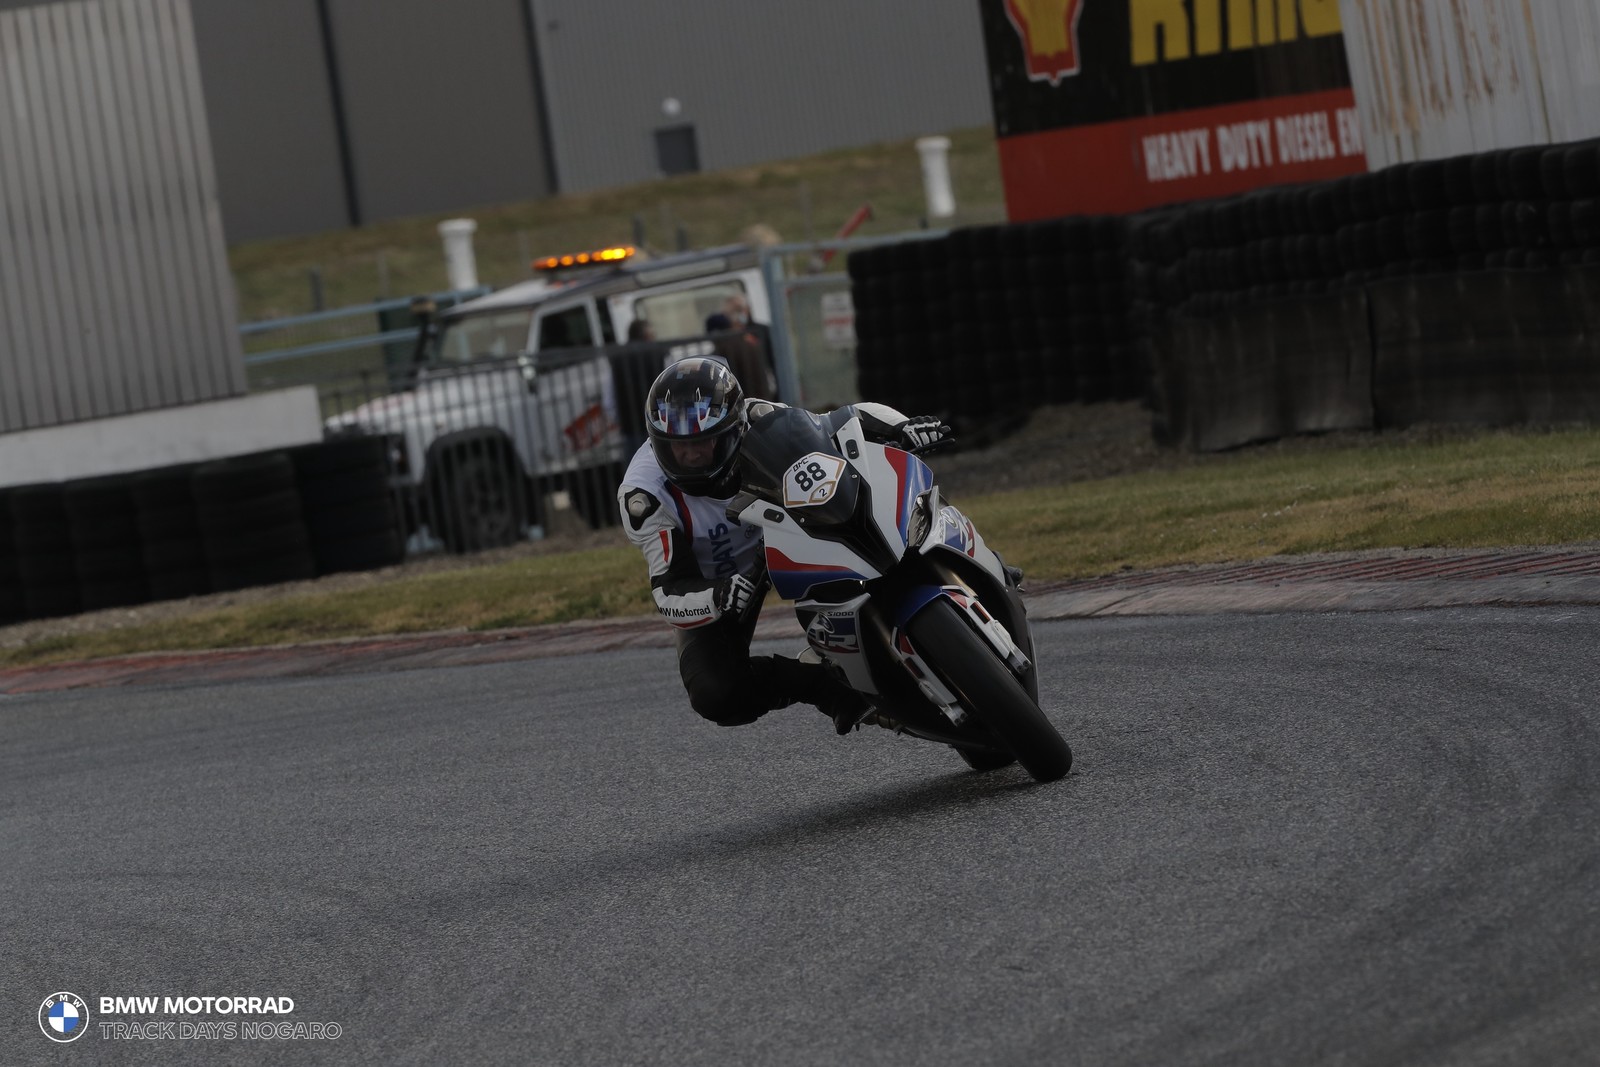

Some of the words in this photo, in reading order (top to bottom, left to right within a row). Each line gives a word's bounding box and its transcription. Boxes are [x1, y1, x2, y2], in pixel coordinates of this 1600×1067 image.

[1142, 127, 1211, 183] HEAVY
[1216, 119, 1273, 172] DUTY
[1274, 110, 1336, 164] DIESEL
[794, 462, 827, 492] 88
[819, 488, 828, 497] 2
[708, 523, 738, 576] DAYS
[672, 605, 711, 618] Motorrad
